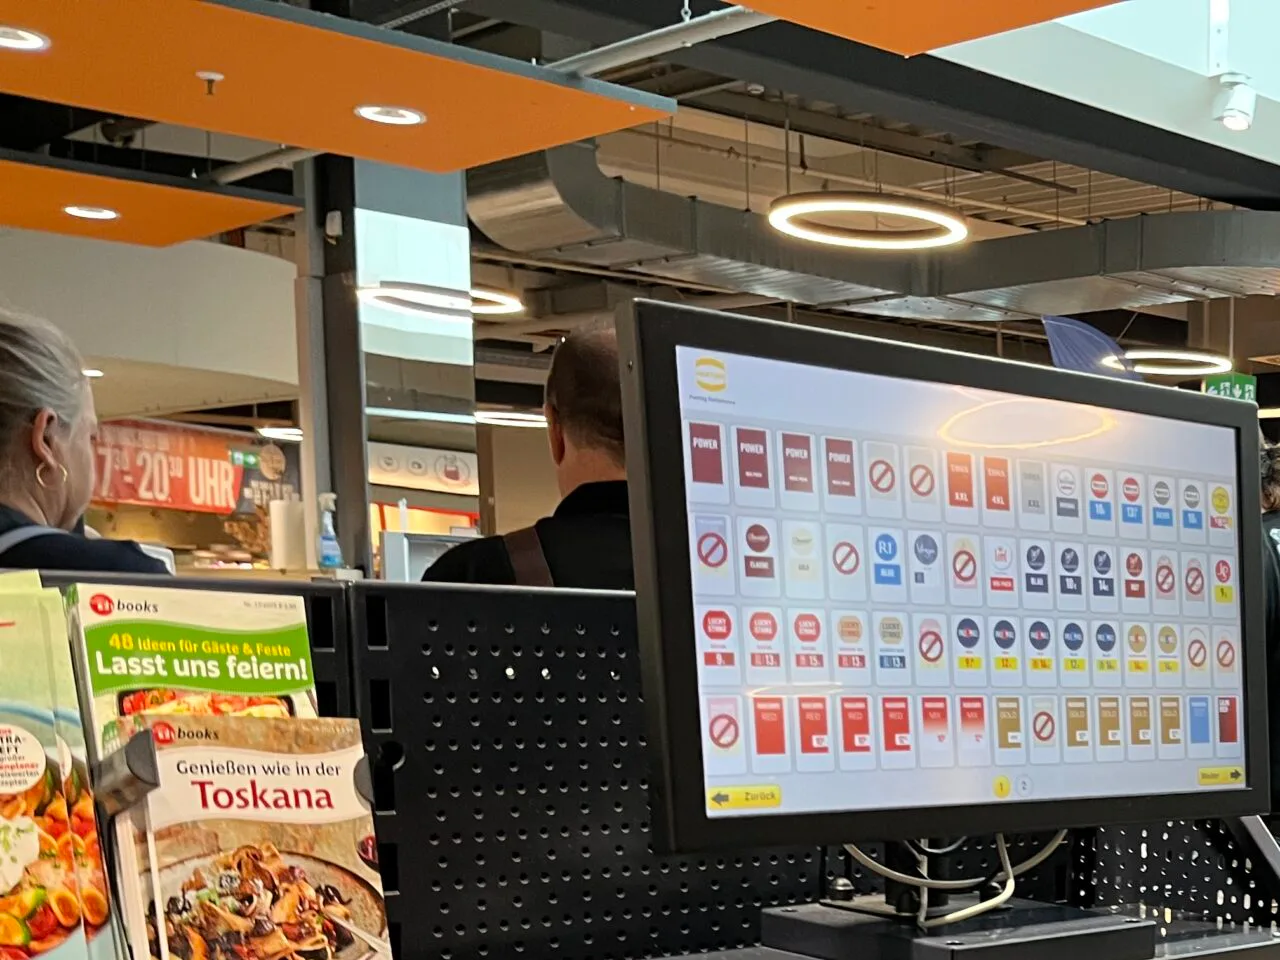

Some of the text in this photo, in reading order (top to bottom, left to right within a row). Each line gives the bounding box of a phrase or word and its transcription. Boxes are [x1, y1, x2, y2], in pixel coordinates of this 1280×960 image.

[692, 437, 718, 449] POWER
[740, 442, 764, 454] POWER
[188, 456, 236, 509] UHR
[117, 600, 159, 613] books
[109, 633, 291, 657] 48 Ideen für Gäste & Feste
[96, 651, 308, 681] Lasst uns feiern!
[177, 727, 219, 740] books
[176, 759, 342, 777] Genießen wie in der
[190, 780, 335, 810] Toskana
[744, 791, 777, 802] Zurück
